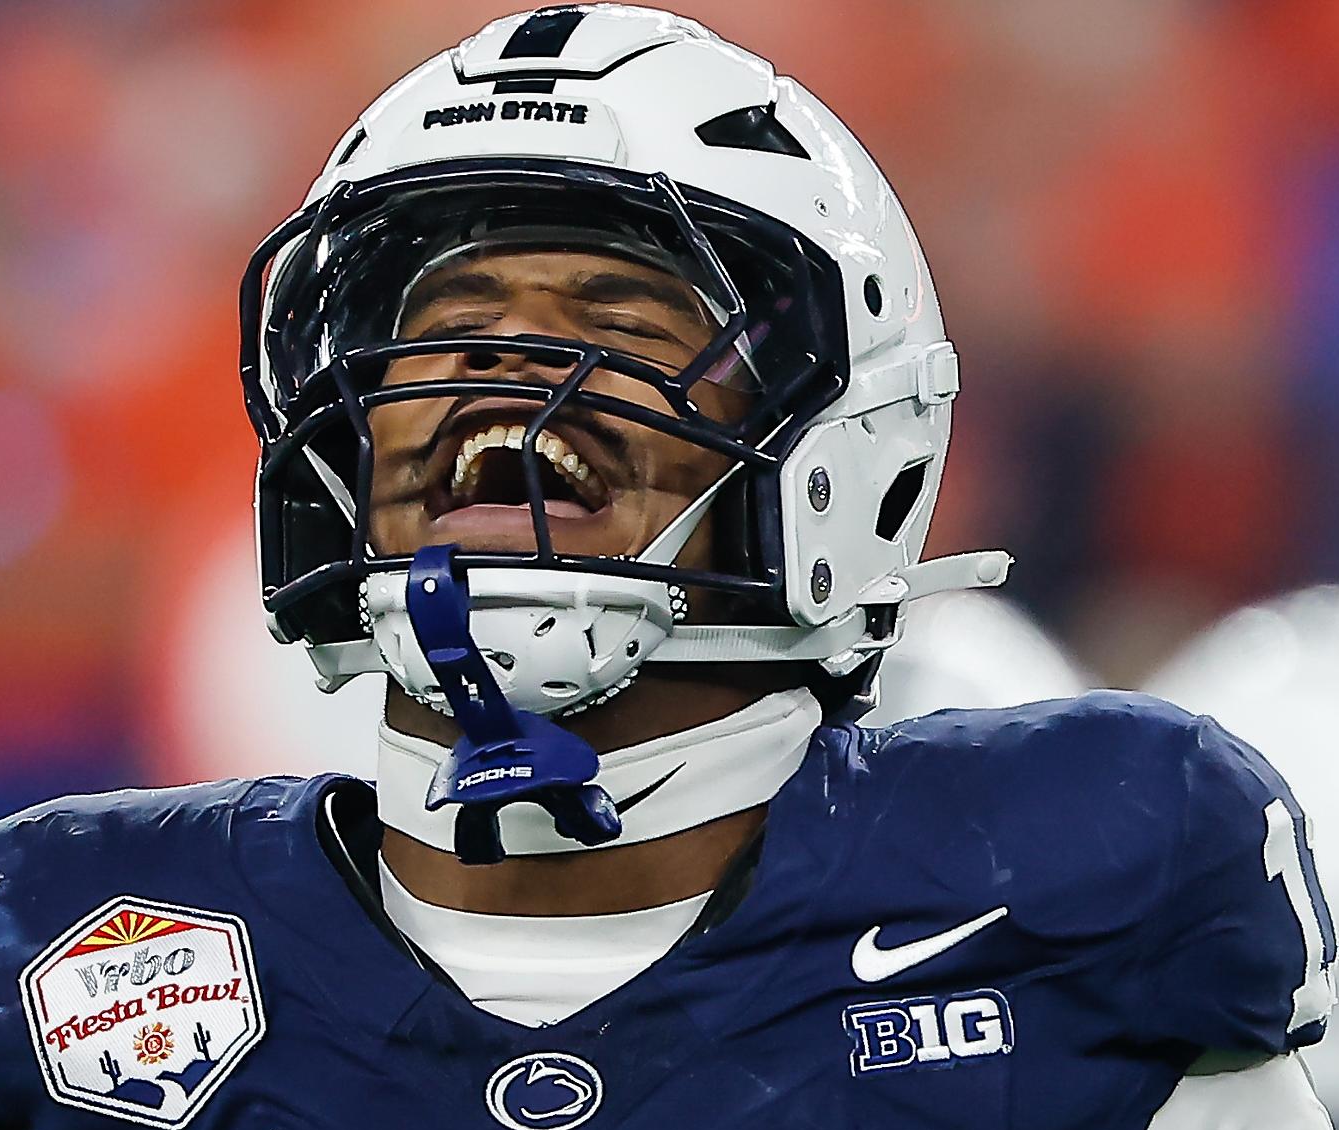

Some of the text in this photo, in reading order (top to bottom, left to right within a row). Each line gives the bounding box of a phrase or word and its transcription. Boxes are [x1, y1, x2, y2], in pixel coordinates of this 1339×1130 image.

[423, 101, 588, 130] PENN STATE
[74, 947, 196, 998] Vrbo
[45, 978, 244, 1053] Fiesta Bowl
